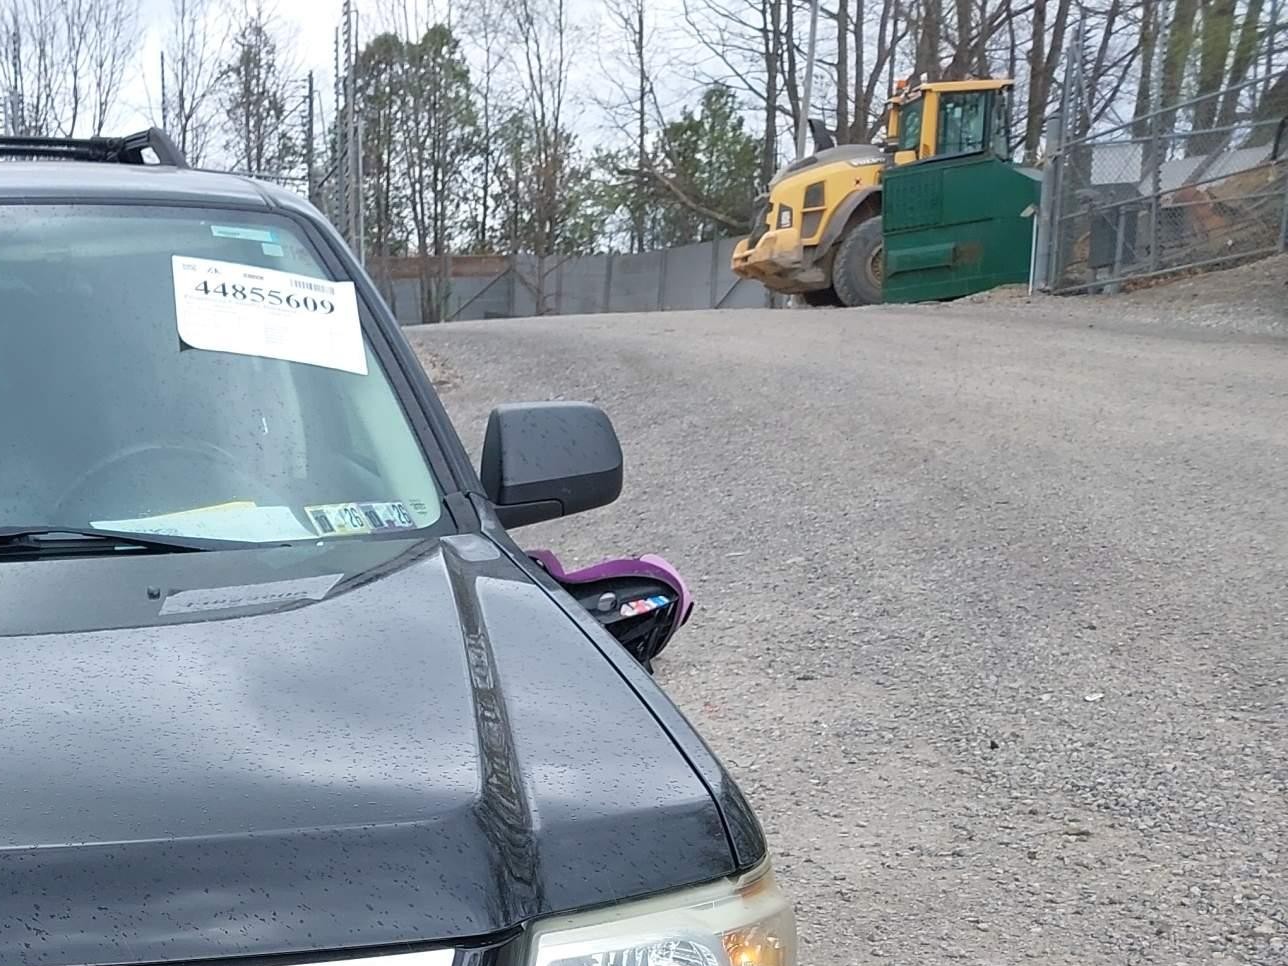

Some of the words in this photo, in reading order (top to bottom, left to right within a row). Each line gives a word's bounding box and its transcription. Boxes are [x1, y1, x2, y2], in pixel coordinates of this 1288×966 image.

[194, 280, 335, 315] 44855609
[344, 507, 364, 528] 26
[392, 503, 412, 524] 26
